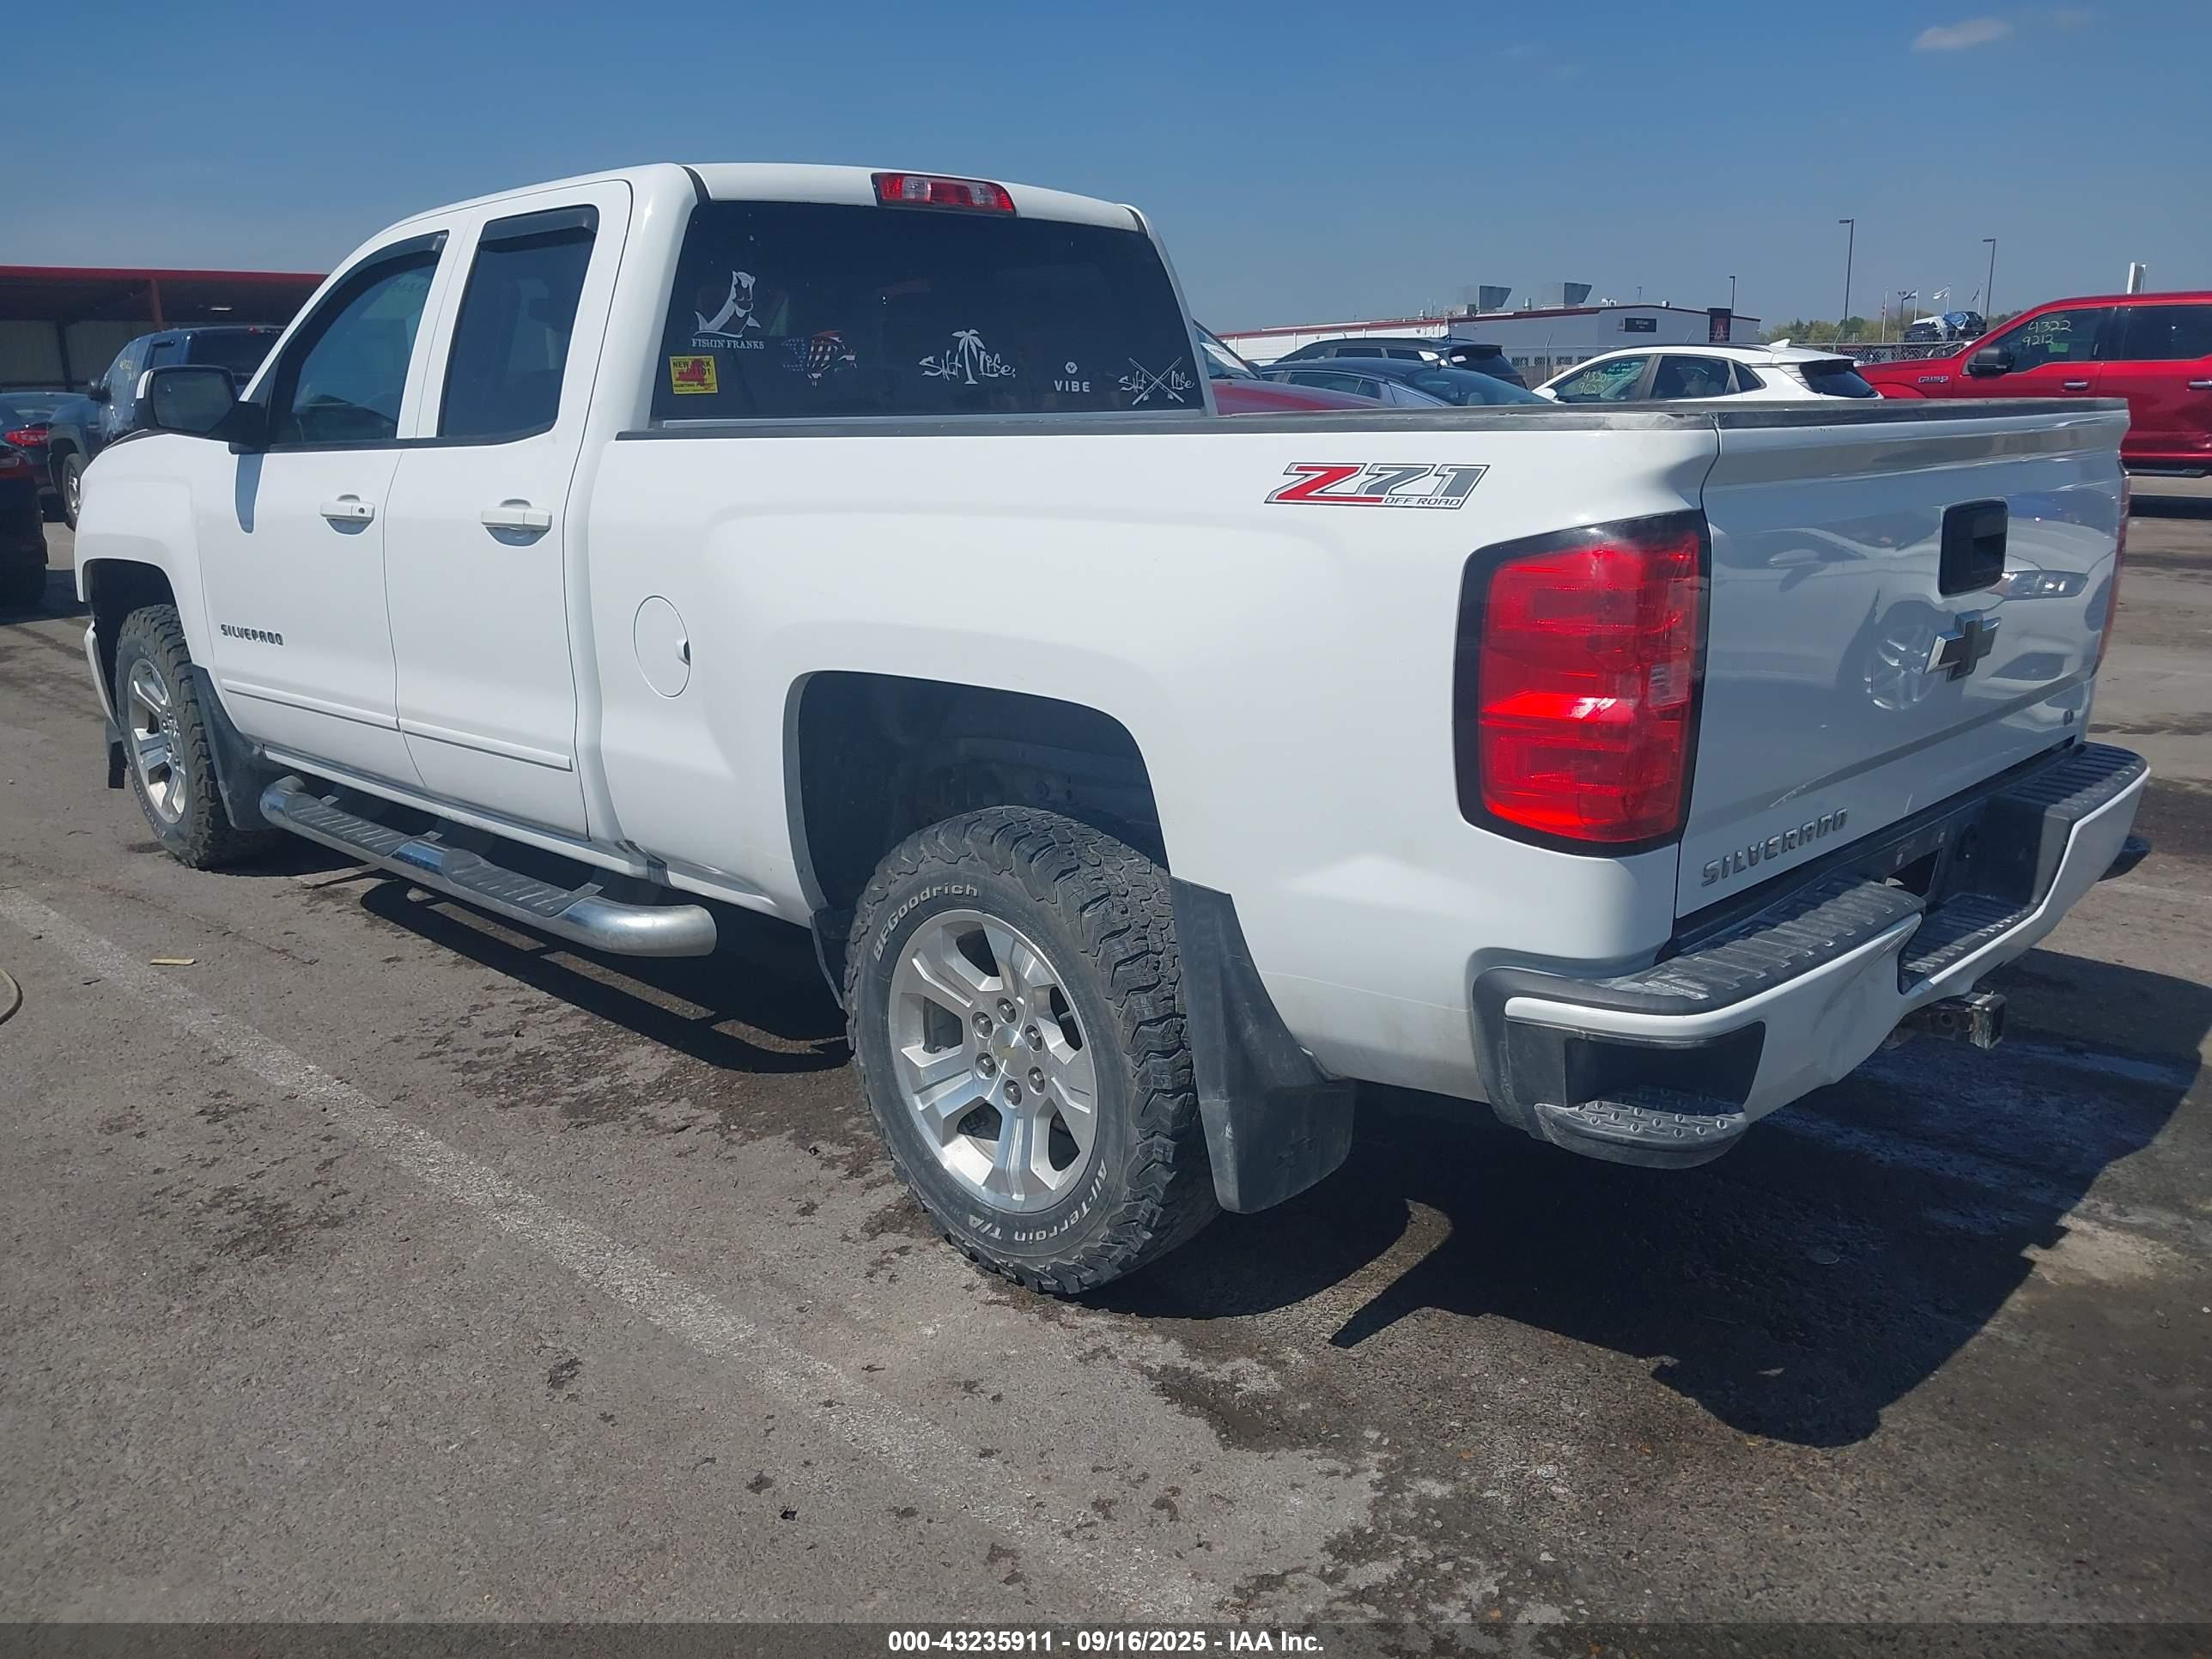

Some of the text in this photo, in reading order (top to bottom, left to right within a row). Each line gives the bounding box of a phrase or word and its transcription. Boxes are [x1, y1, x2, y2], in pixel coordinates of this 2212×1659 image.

[2027, 320, 2073, 333] 4322
[726, 340, 764, 349] FRANKS
[1054, 380, 1091, 392] VIBE
[1263, 462, 1491, 510] Z71
[1416, 497, 1461, 507] ROAD
[220, 623, 284, 647] SILVERADO
[1701, 807, 1849, 887] SILVERADO
[872, 882, 979, 963] BFGoodrich
[968, 1213, 1003, 1240] T/A
